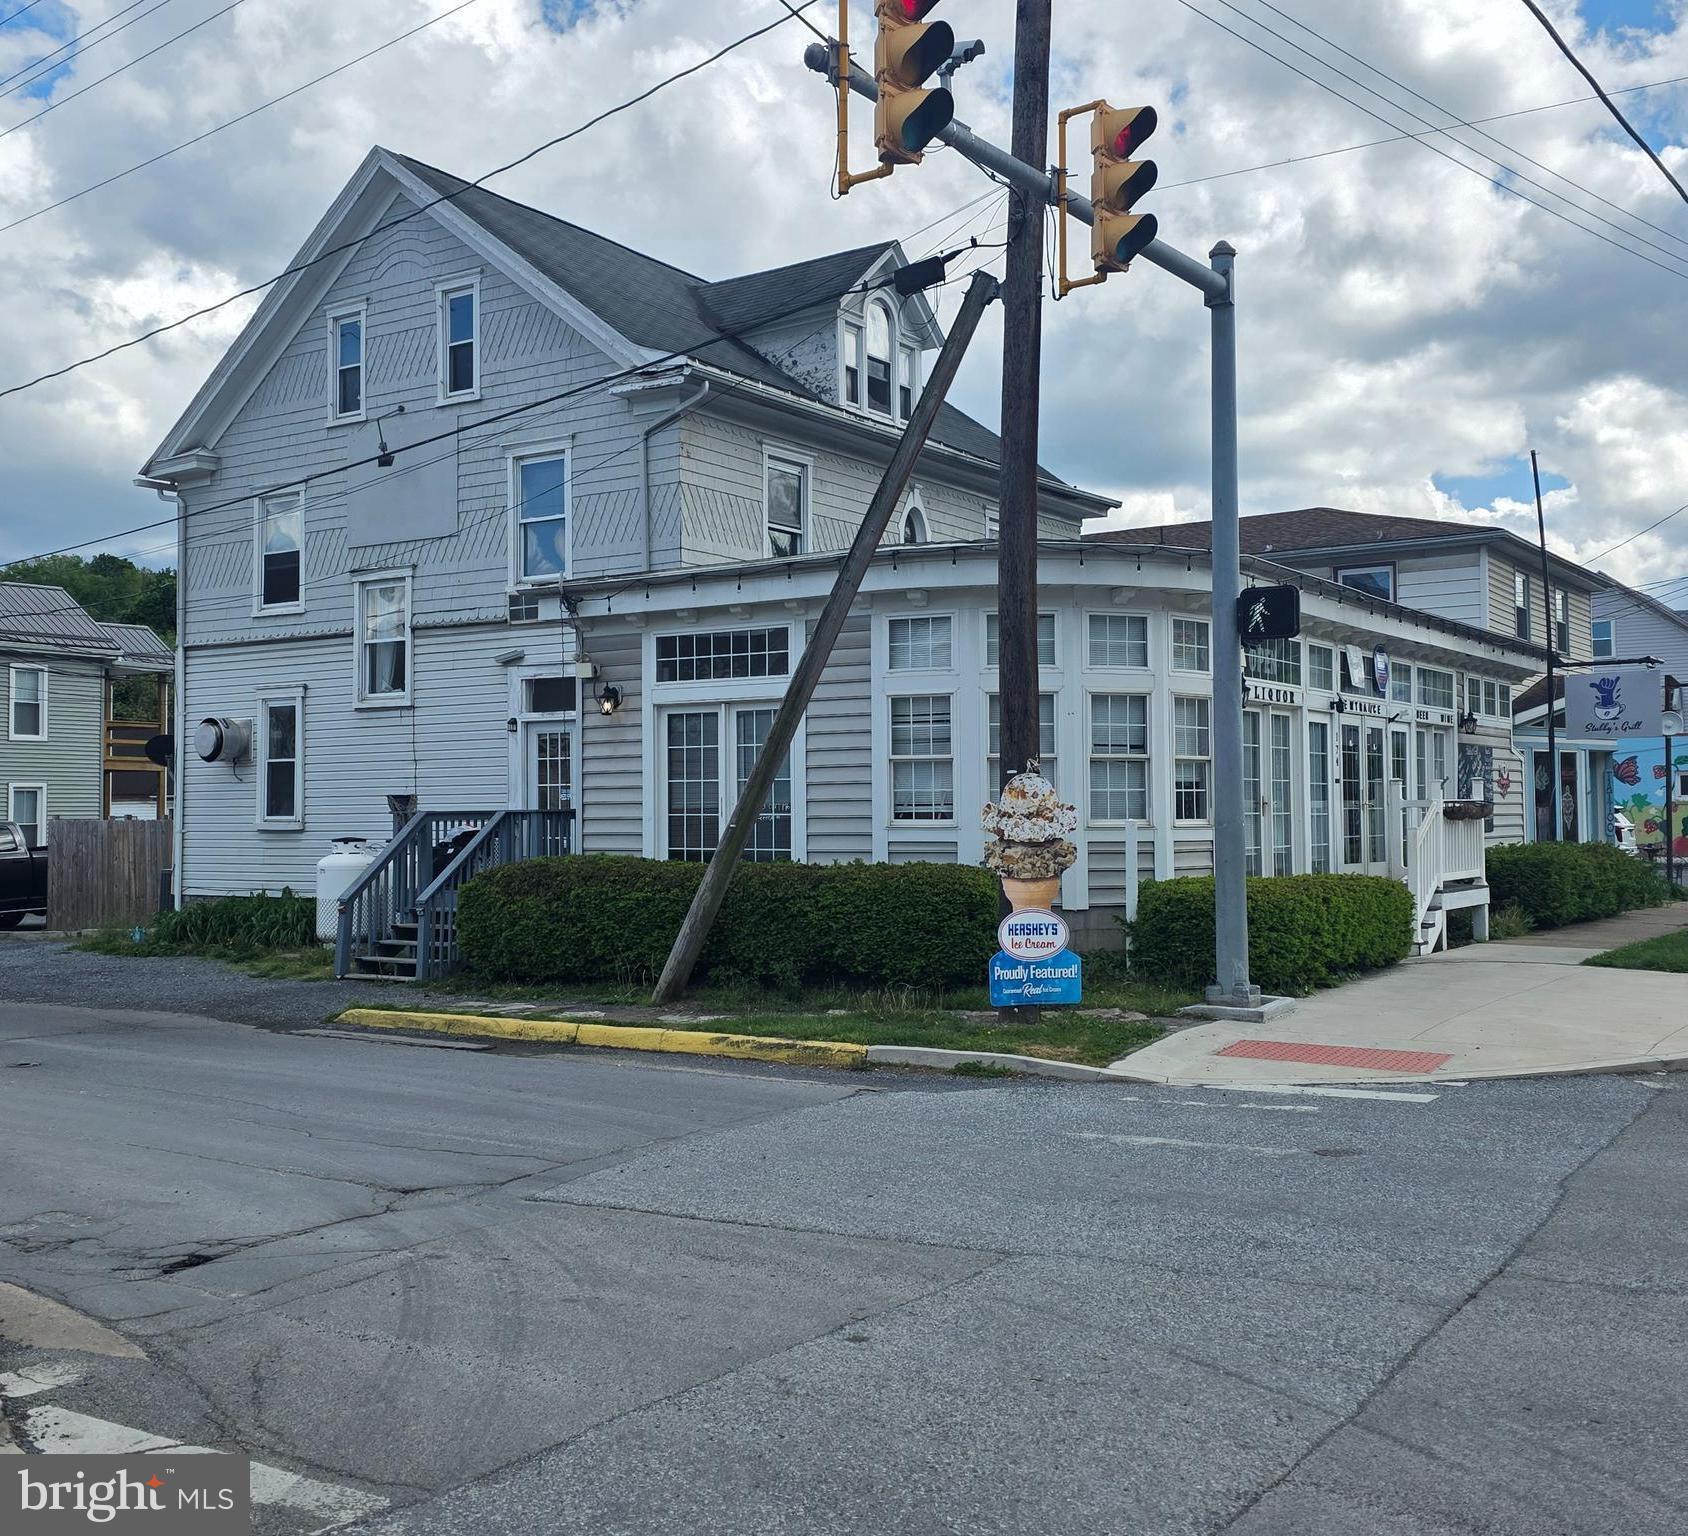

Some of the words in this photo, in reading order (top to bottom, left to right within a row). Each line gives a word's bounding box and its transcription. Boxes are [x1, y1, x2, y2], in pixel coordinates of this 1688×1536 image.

[1254, 686, 1295, 703] LIQUOR
[1621, 721, 1643, 732] Grill
[1008, 923, 1058, 936] HERSHEY'S
[1011, 938, 1023, 949] Ice
[1024, 938, 1057, 949] Cream
[995, 965, 1029, 982] Proudly
[1030, 964, 1078, 979] Featured!
[1022, 983, 1043, 997] Real
